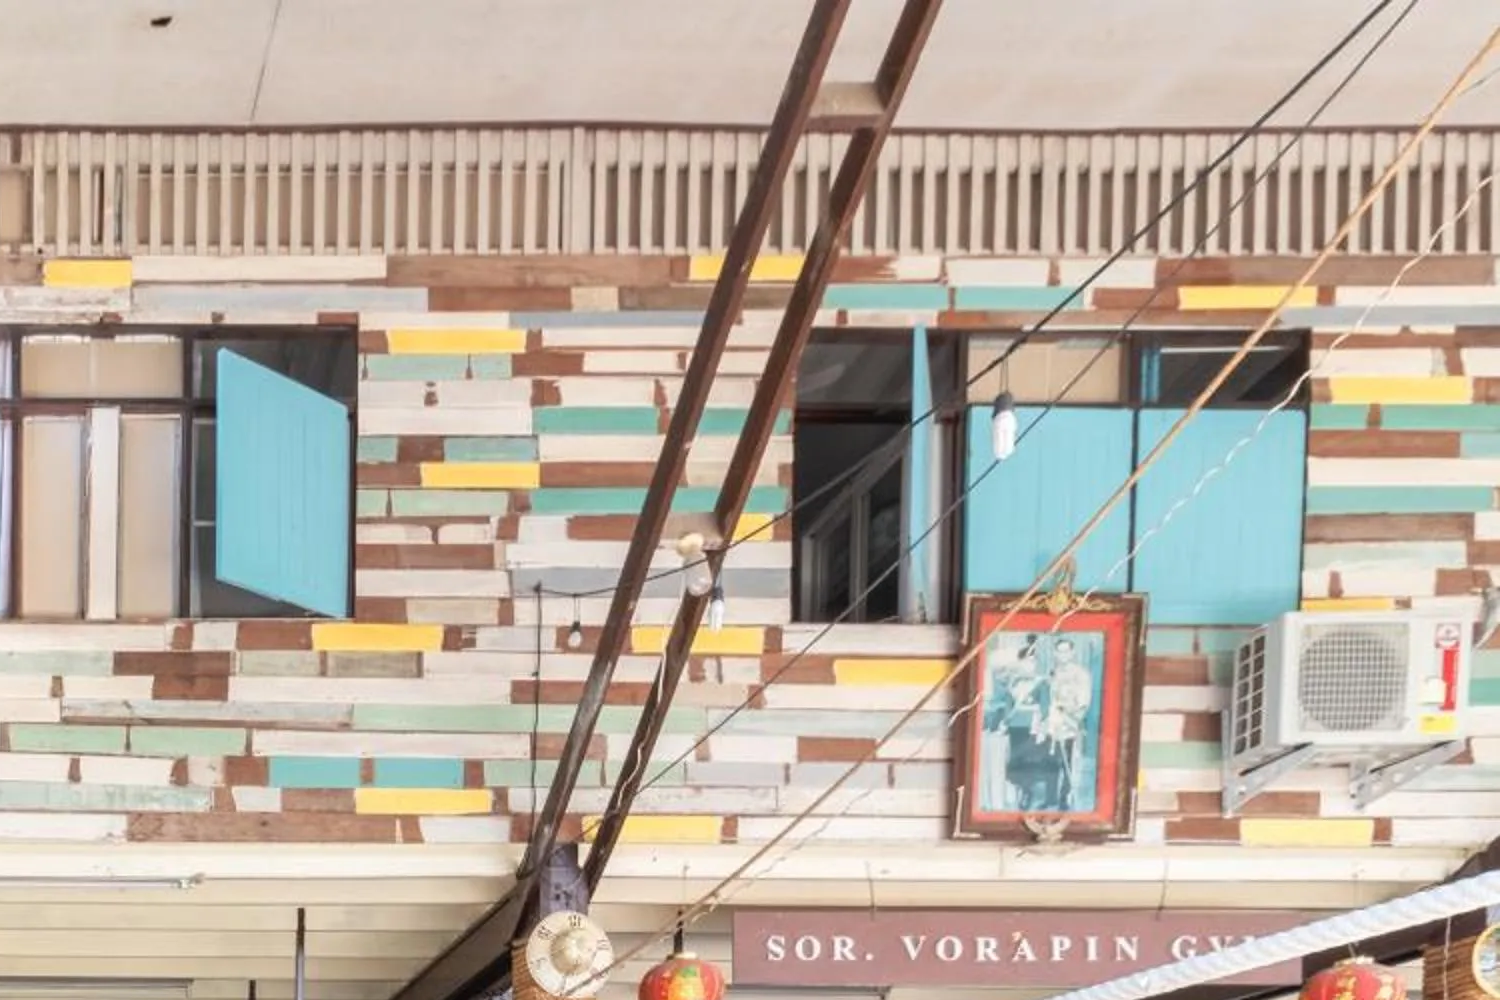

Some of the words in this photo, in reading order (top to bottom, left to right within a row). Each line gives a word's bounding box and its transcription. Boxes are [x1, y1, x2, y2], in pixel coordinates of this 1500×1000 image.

[766, 935, 875, 961] SOR.
[901, 935, 1140, 961] VORAPIN
[1171, 935, 1257, 960] GY
